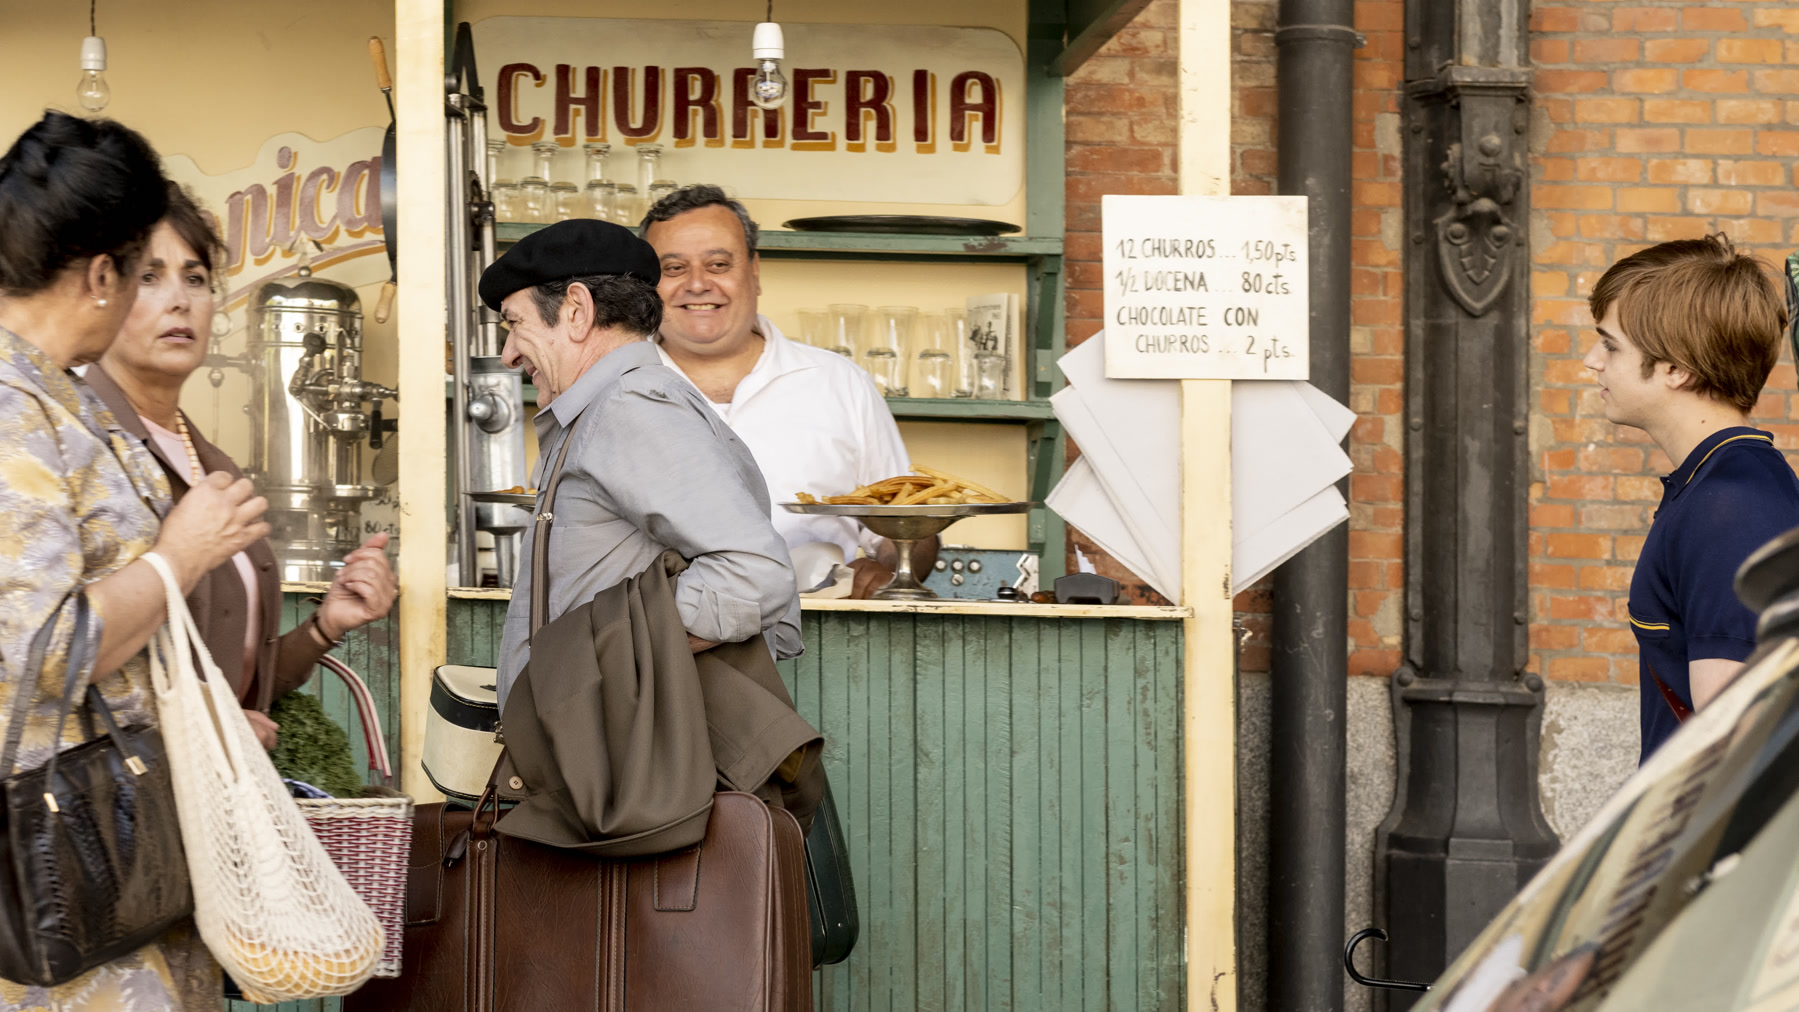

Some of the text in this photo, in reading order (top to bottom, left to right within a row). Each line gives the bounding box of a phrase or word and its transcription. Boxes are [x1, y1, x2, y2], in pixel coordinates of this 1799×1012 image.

[497, 62, 1001, 154] CHURRERIA
[1115, 239, 1138, 259] 12
[1117, 306, 1259, 327] CHOCOLATE CON
[1245, 335, 1256, 355] 2
